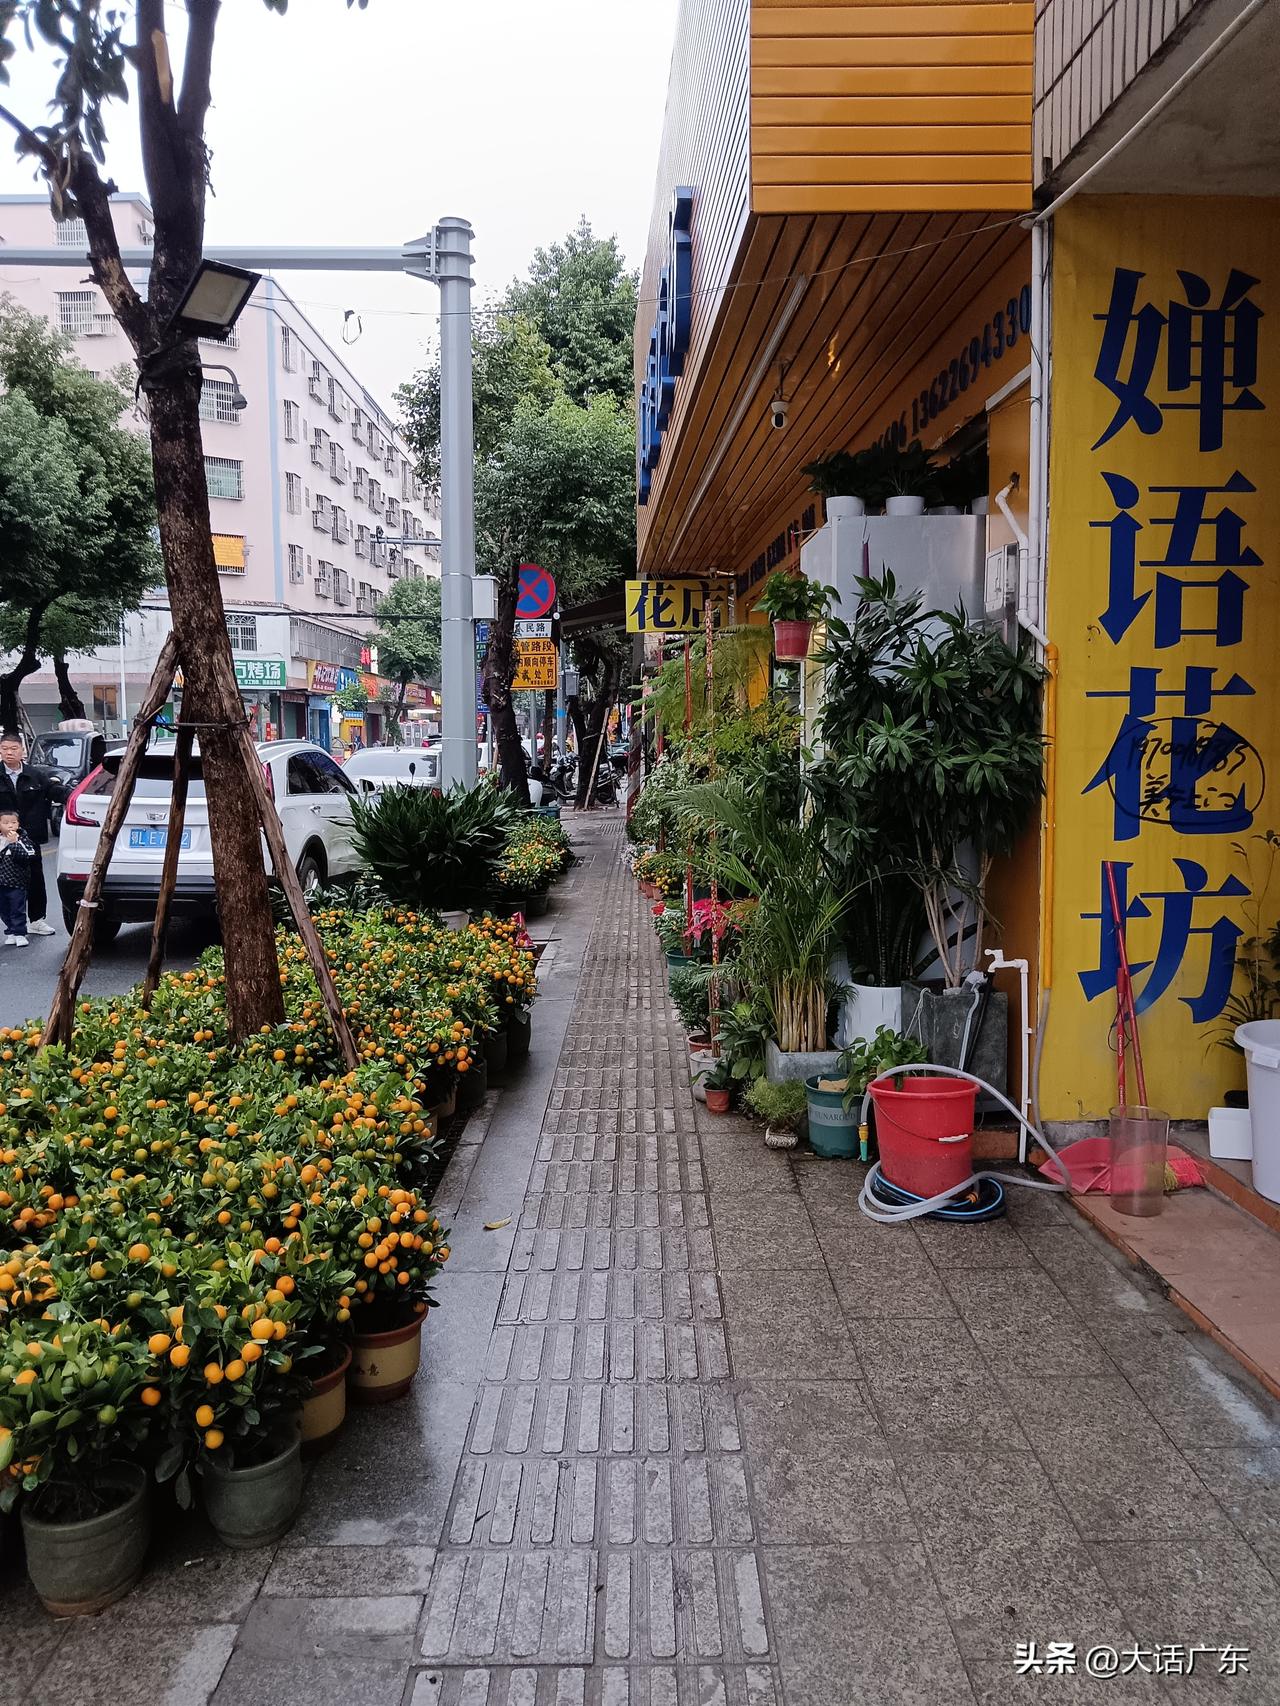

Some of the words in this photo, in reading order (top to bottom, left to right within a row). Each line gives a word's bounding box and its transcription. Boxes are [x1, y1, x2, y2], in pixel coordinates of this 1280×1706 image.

[629, 582, 726, 630] 花店
[513, 640, 552, 652] 管路段
[1078, 267, 1266, 1025] 婵语花坊
[515, 655, 554, 668] 内顺向停车
